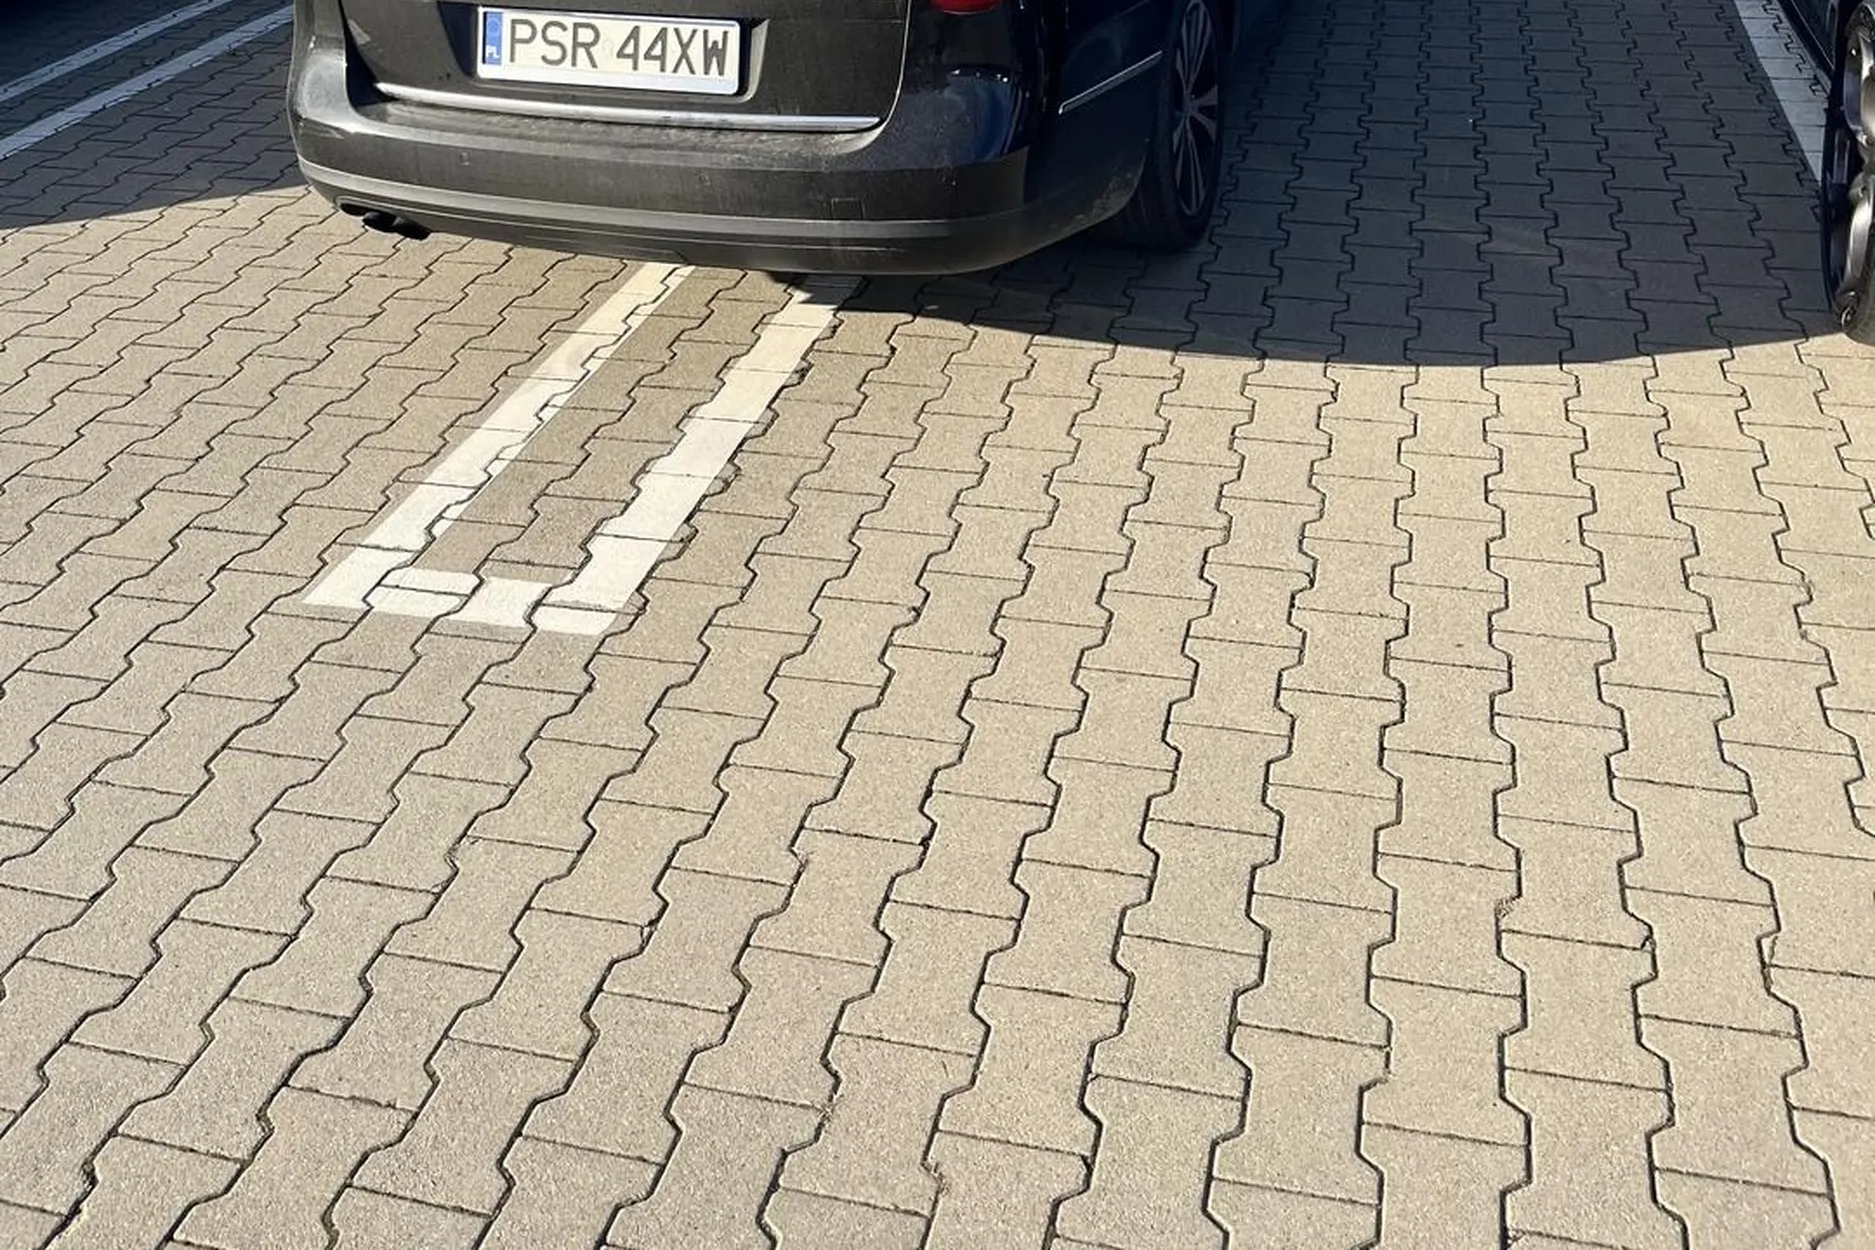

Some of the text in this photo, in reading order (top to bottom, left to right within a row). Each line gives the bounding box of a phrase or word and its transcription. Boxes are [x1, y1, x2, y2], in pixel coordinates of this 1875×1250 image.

[486, 44, 500, 59] PL
[509, 18, 728, 76] PSR 44XW
